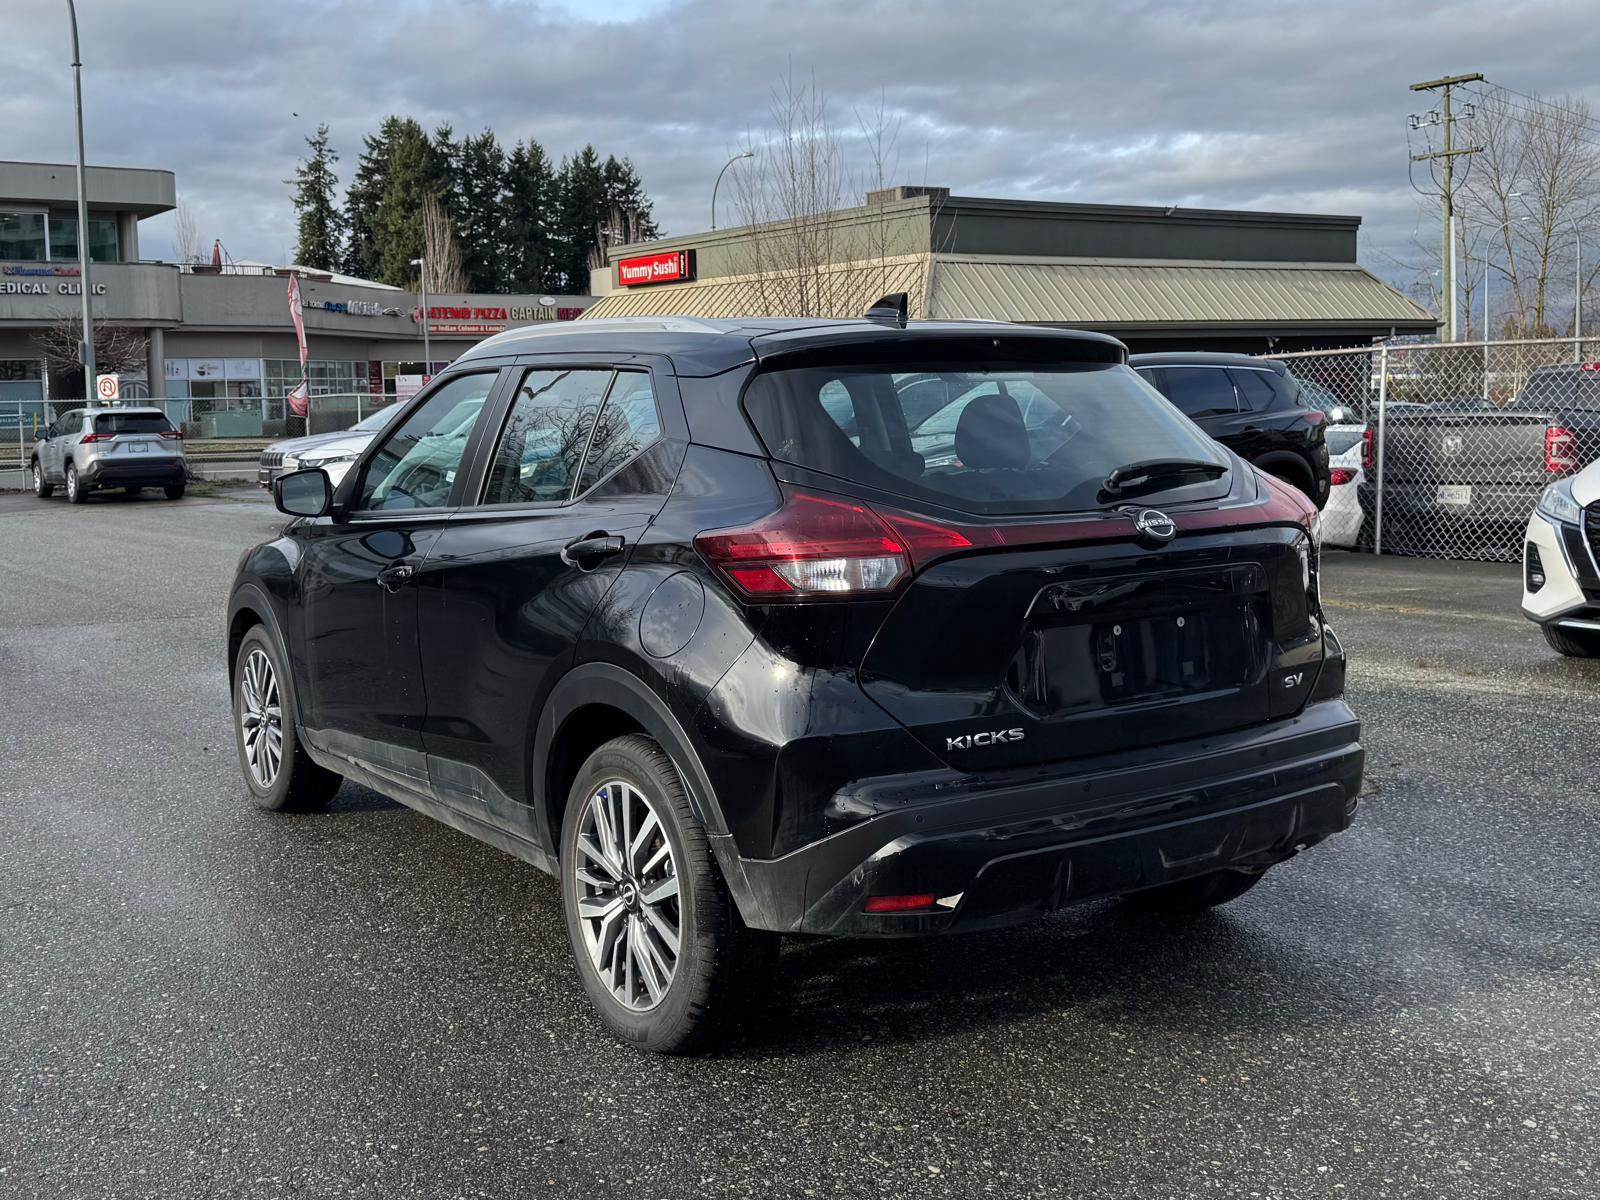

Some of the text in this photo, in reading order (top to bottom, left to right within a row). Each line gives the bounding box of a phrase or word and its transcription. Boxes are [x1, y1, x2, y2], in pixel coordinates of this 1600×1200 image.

[621, 264, 653, 280] Yummy
[653, 257, 677, 275] Sushi
[0, 282, 106, 294] EDICAL CLIIC
[474, 307, 508, 320] PIZZA
[511, 307, 554, 320] CAPTAIN
[1137, 518, 1176, 529] NISSAN
[1284, 672, 1303, 688] SV
[945, 727, 1025, 751] KICKS
